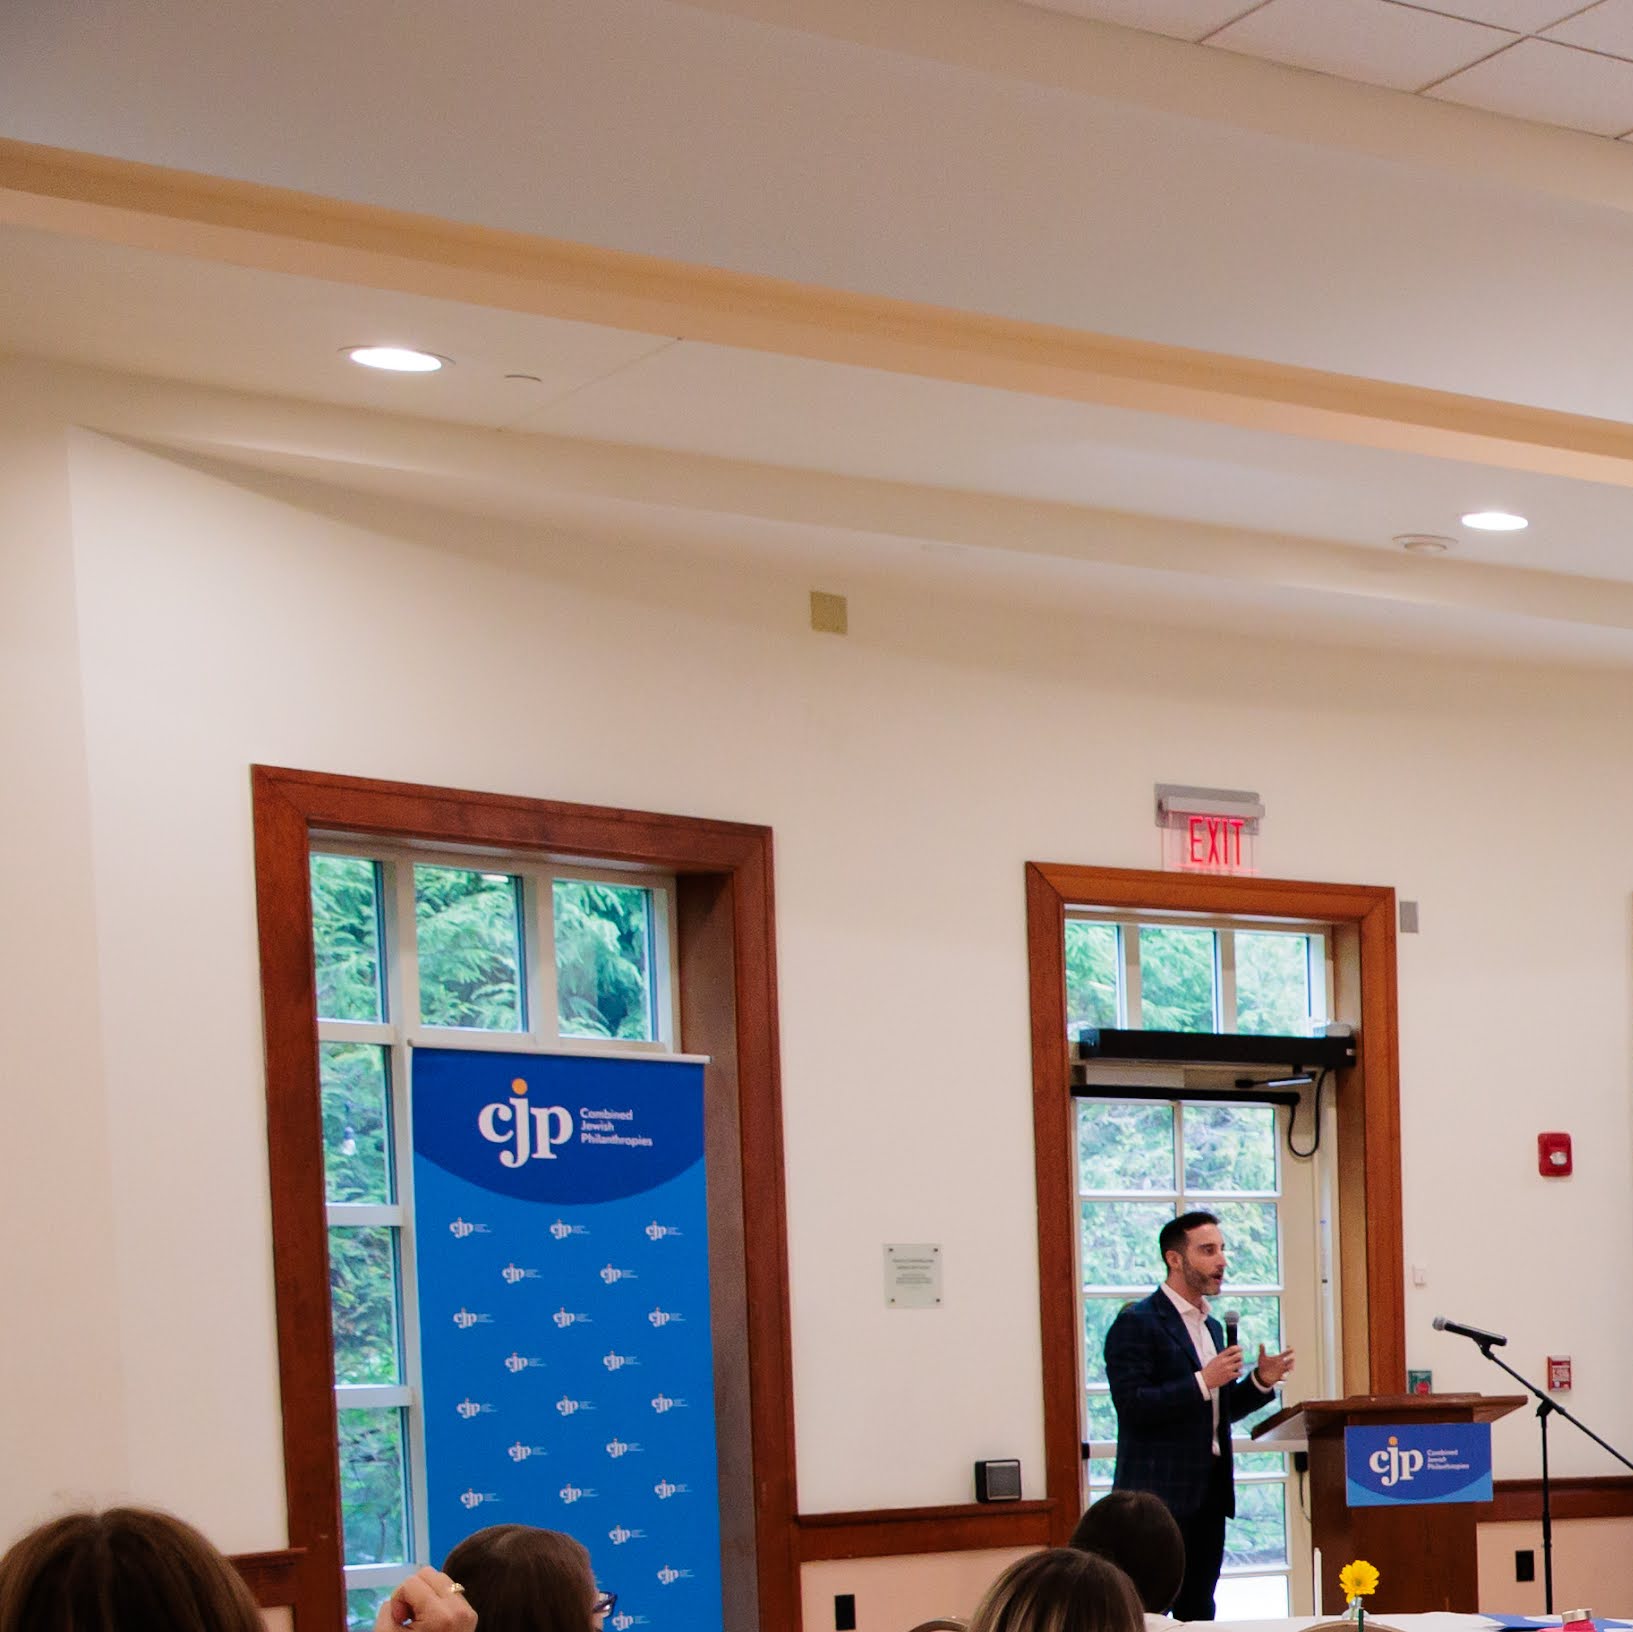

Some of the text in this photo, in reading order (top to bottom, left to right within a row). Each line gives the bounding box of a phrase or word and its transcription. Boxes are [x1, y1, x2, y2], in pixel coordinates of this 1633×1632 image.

[1189, 817, 1245, 867] EXIT
[477, 1078, 574, 1169] cjp
[580, 1107, 633, 1120] Combined
[580, 1120, 614, 1132] Jewish
[580, 1132, 653, 1148] Philanthropies
[1369, 1435, 1424, 1487] cjp
